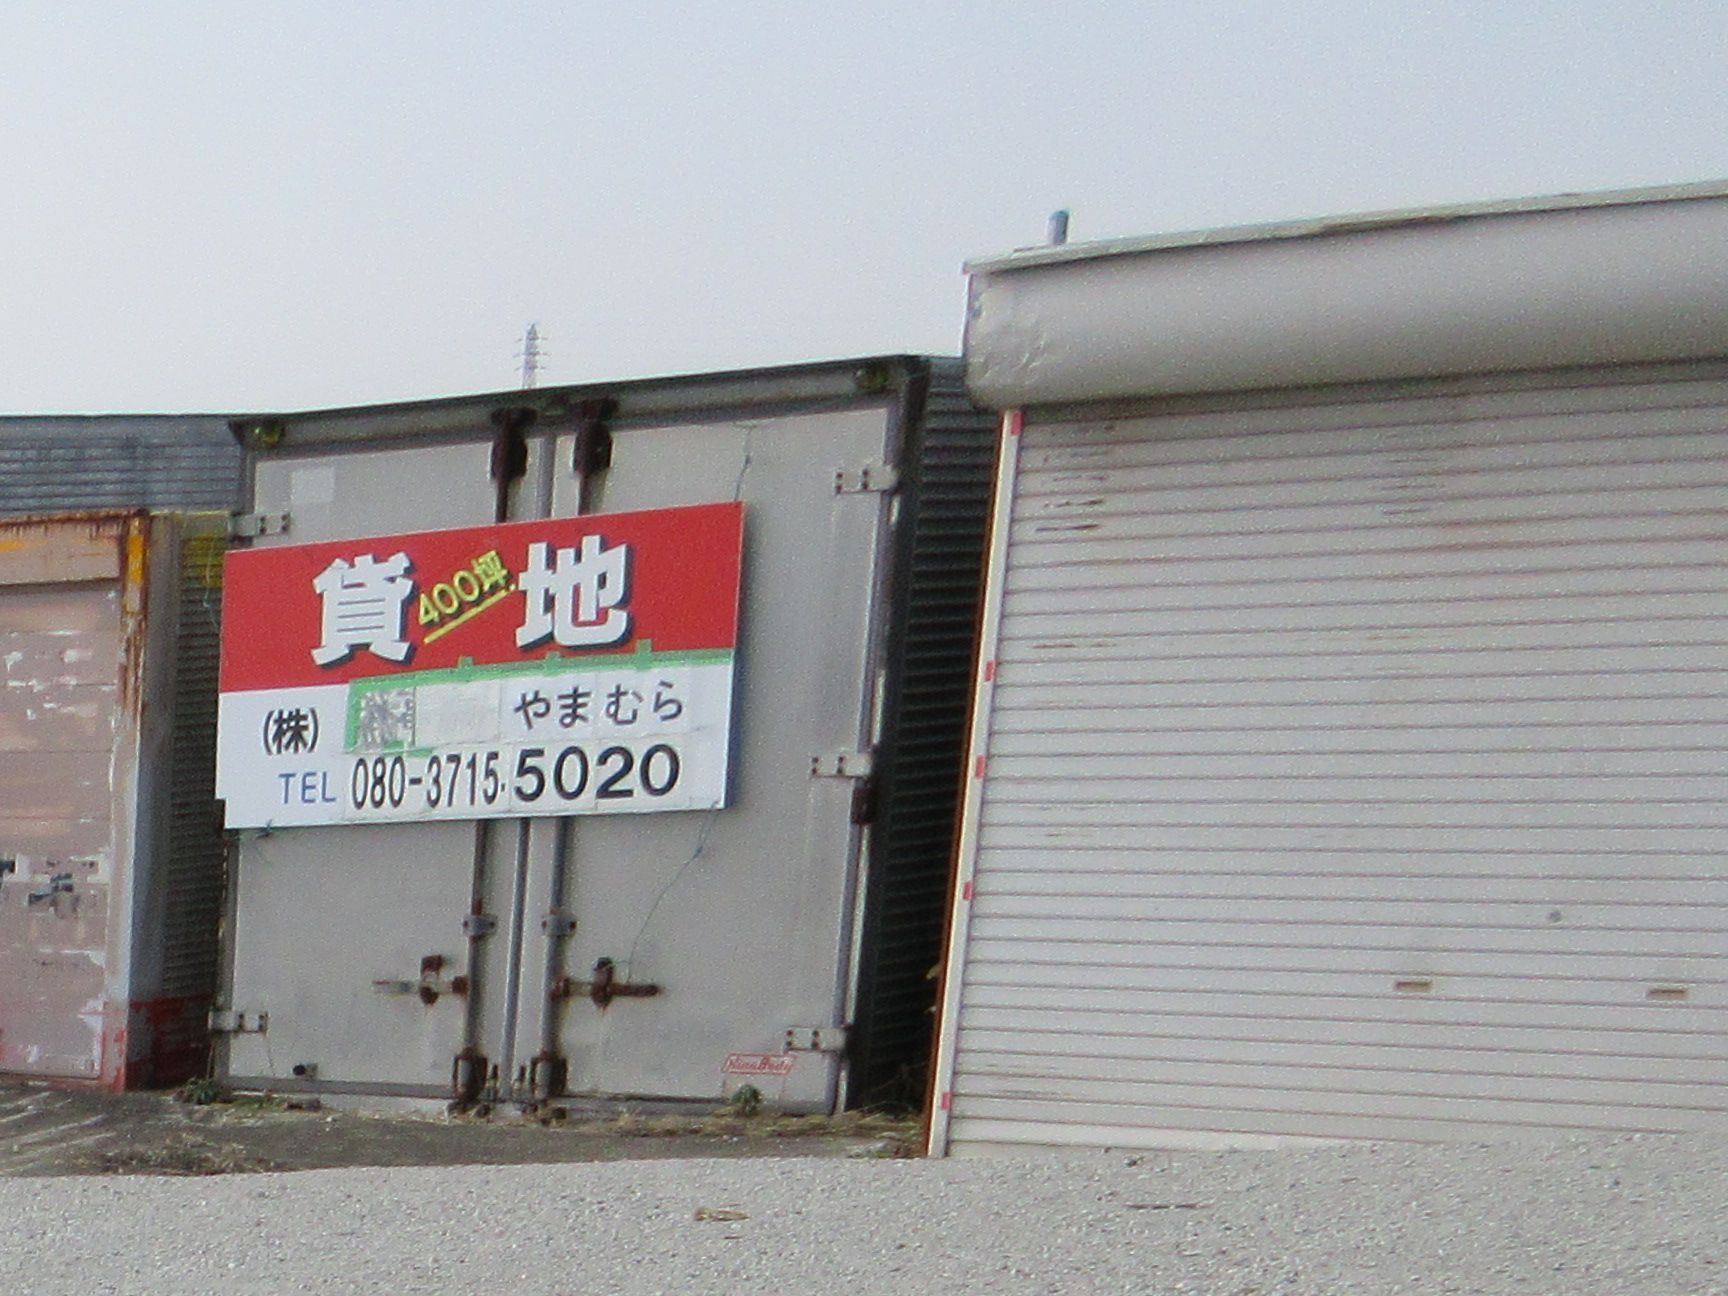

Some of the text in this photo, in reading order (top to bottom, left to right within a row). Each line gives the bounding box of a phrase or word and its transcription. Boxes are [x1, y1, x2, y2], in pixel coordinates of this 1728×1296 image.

[513, 681, 683, 730] やまむら
[278, 771, 337, 805] TEL
